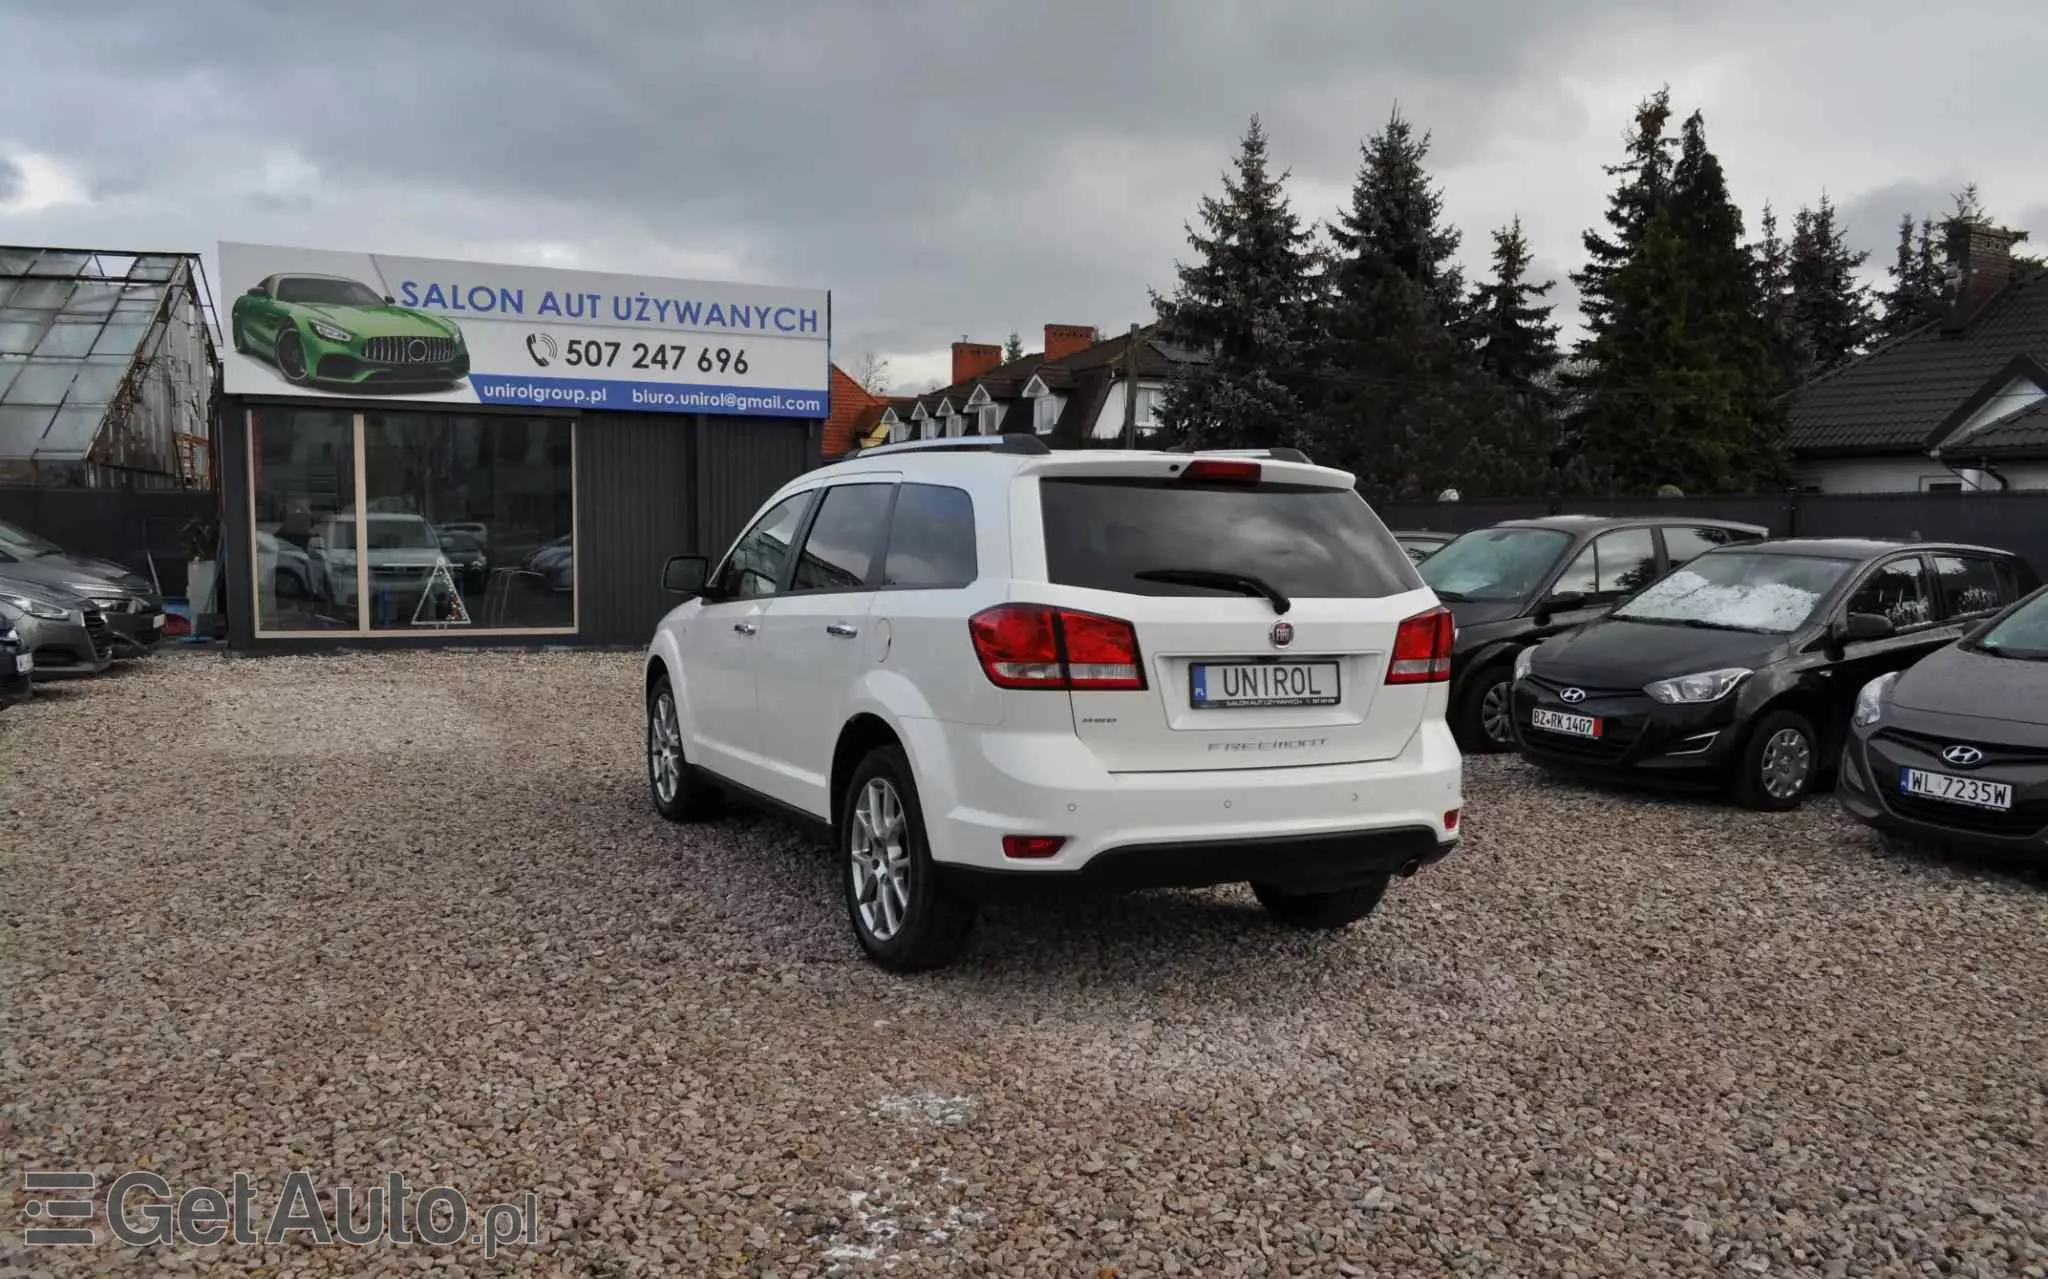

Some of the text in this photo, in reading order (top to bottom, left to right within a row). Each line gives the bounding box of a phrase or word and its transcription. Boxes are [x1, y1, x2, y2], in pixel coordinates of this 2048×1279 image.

[401, 281, 817, 332] SALON AUT UŻYWANYCH
[565, 339, 749, 375] 507 247 696
[483, 384, 820, 412] unirolgroup.pl biuro.unirol@gmail.com
[1223, 666, 1321, 696] UNIROL
[1912, 771, 1934, 793] WL
[1943, 777, 2007, 805] 7235W
